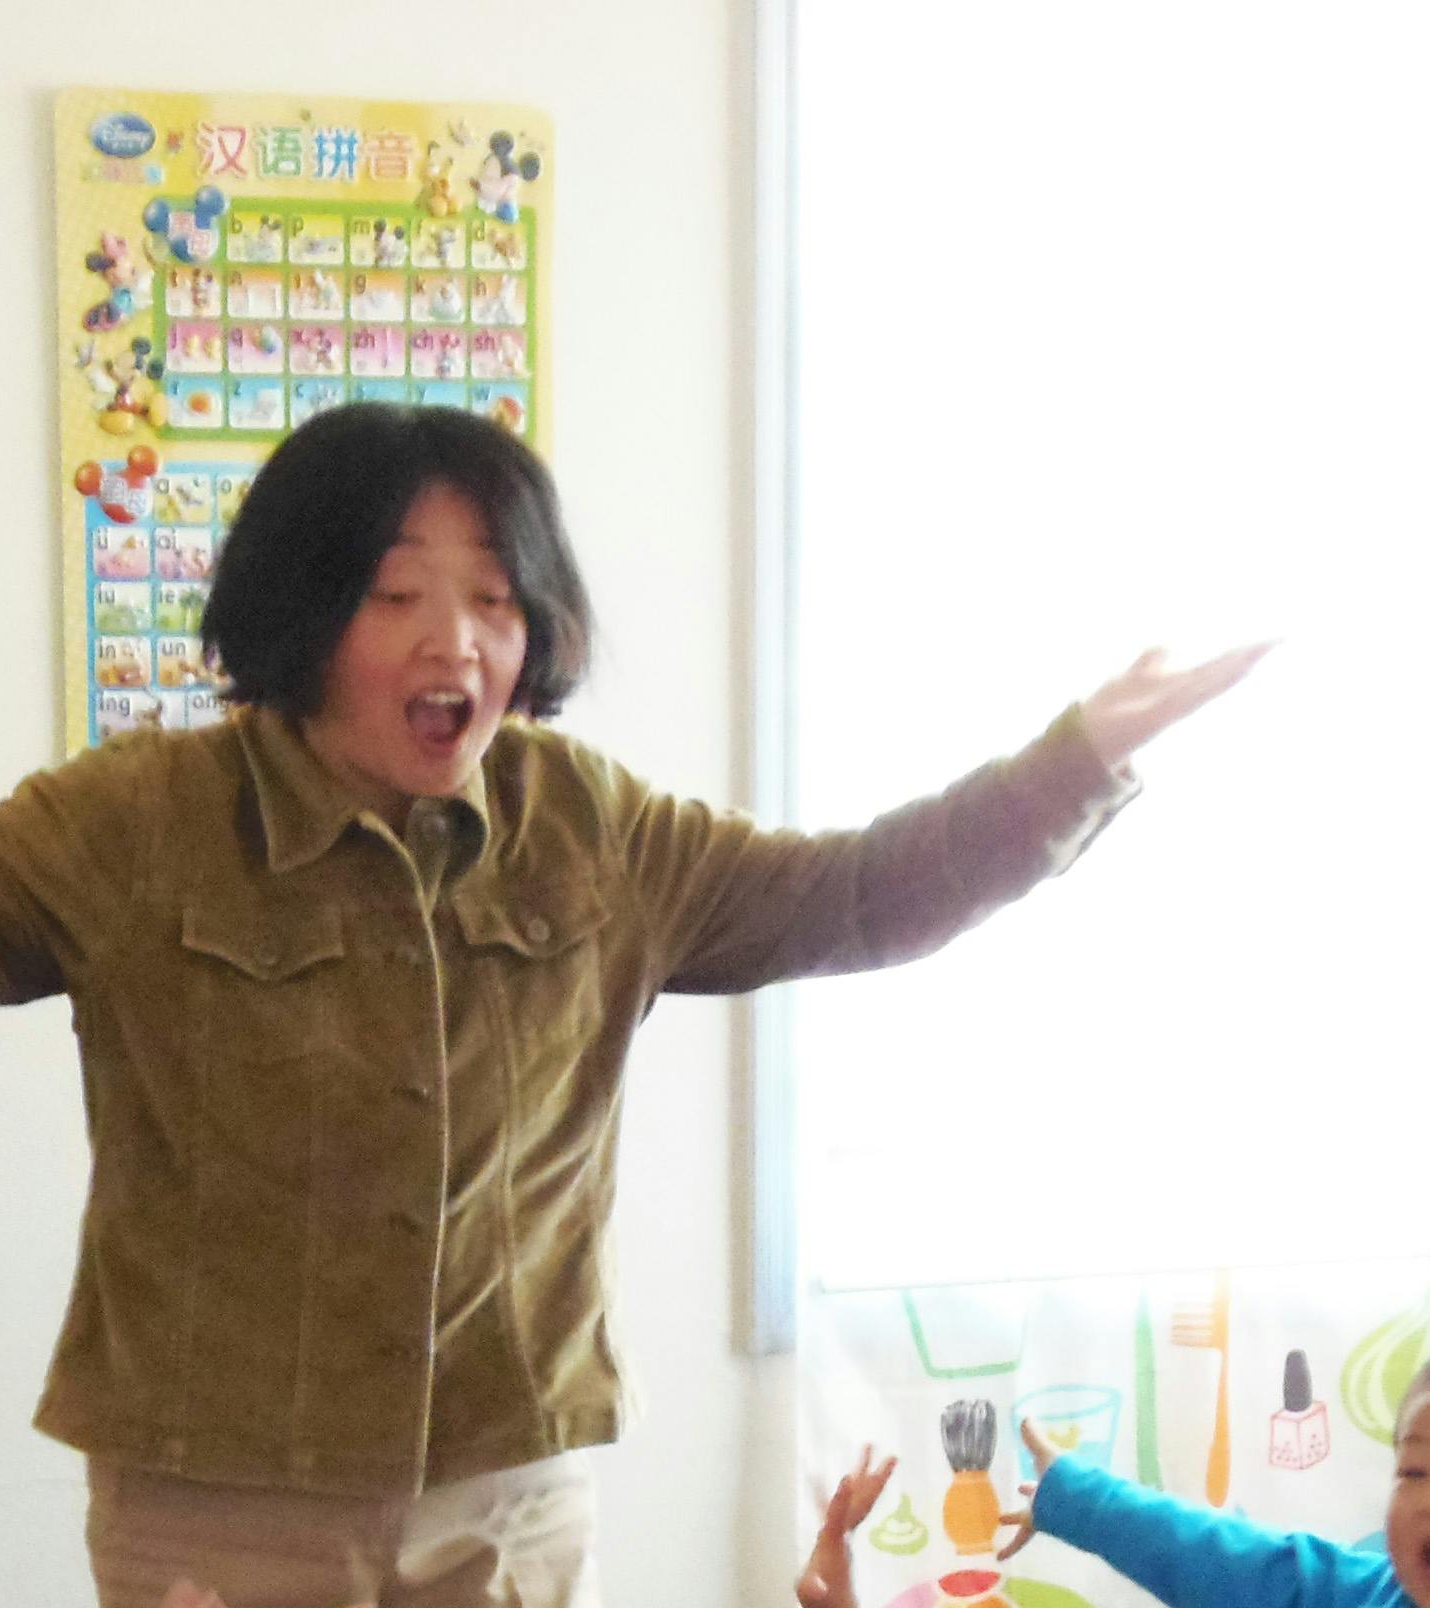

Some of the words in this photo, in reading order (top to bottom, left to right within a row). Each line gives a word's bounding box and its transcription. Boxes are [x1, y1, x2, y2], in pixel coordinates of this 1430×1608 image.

[198, 122, 415, 179] 汉语拼音
[161, 641, 187, 657] un
[98, 691, 131, 717] ing
